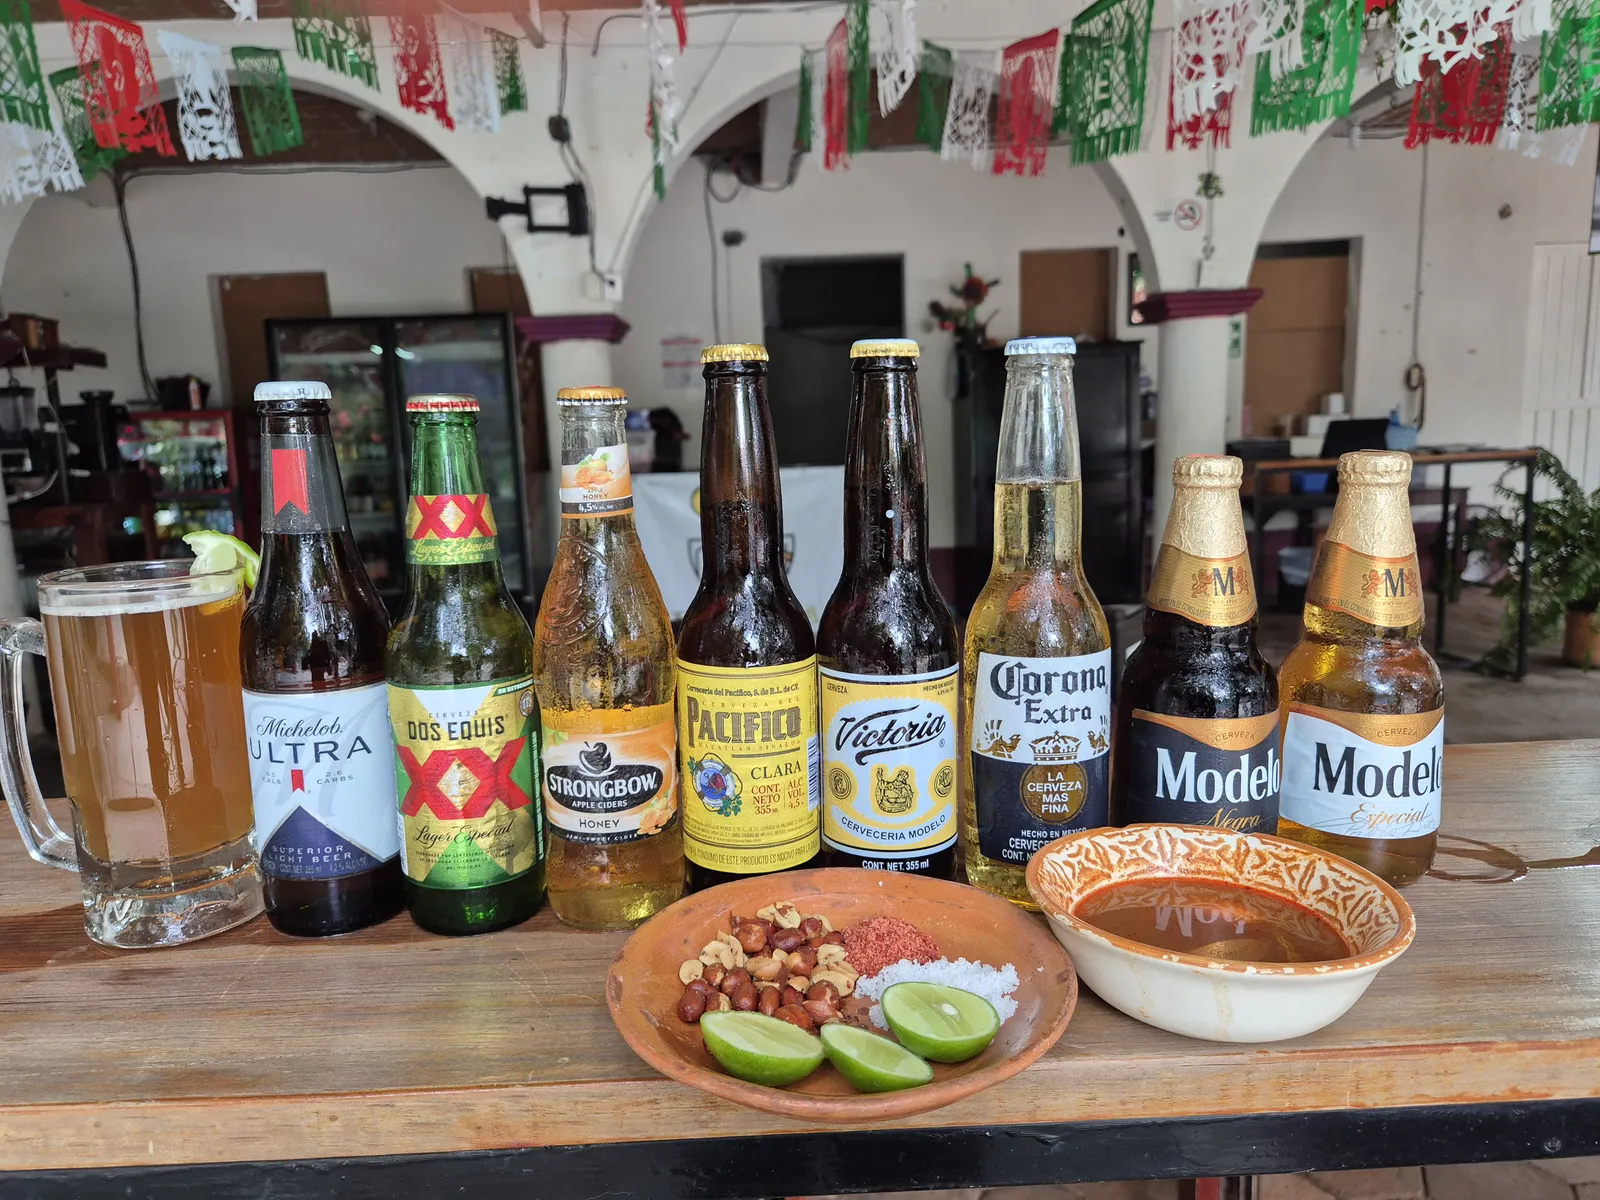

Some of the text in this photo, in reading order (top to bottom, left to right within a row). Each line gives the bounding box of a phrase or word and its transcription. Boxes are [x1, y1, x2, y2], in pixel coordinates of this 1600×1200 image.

[1212, 567, 1235, 597] M
[1384, 568, 1406, 598] M
[826, 682, 848, 694] CERVEZA
[990, 660, 1107, 706] Corona
[714, 688, 724, 696] del
[760, 688, 769, 696] de
[770, 686, 782, 695] R.L.
[783, 685, 790, 693] de
[701, 696, 800, 709] CERVEZA DEL
[428, 710, 479, 719] CERVEZA
[1024, 699, 1092, 724] Extra
[256, 715, 341, 738] Michelob
[407, 715, 505, 741] DOS EQUIS
[687, 695, 801, 748] PACIFICO
[835, 704, 946, 759] Victoria
[1215, 730, 1256, 742] CERVEZA
[1376, 728, 1419, 739] CERVEZA
[249, 735, 373, 764] ULTRA
[750, 760, 801, 780] CLARA
[1155, 746, 1280, 803] Modelo
[262, 776, 282, 785] CALS
[316, 774, 354, 785] CARBS
[396, 736, 532, 821] XX
[1047, 772, 1064, 782] LA
[549, 771, 657, 798] STRONGBOW
[751, 783, 781, 795] CONT.
[1027, 781, 1082, 793] CERVEZA
[753, 793, 781, 805] NETO
[787, 788, 805, 799] VOL.
[1042, 793, 1069, 803] MAS
[571, 800, 628, 809] APPLE CIDERS
[754, 805, 772, 815] 355
[1041, 804, 1069, 814] FINA
[1204, 807, 1260, 832] Negra
[1350, 802, 1430, 829] Especial
[579, 818, 620, 829] HONEY
[841, 816, 906, 840] CERVECERIA
[908, 814, 946, 839] MODELO
[413, 819, 515, 849] Lager Especial
[1021, 829, 1048, 838] HECHO
[1049, 830, 1060, 838] EN
[272, 844, 344, 855] SUPERIOR
[1009, 837, 1053, 851] CERVECE
[269, 853, 303, 863] LIGHT
[312, 852, 352, 863] BEER
[718, 853, 725, 864] DE
[726, 854, 739, 866] ESTE
[740, 855, 769, 866] PRODUCTO
[770, 853, 777, 864] ES
[1002, 848, 1025, 861] CONT.
[862, 858, 929, 871] CONT. NET. 355 ml
